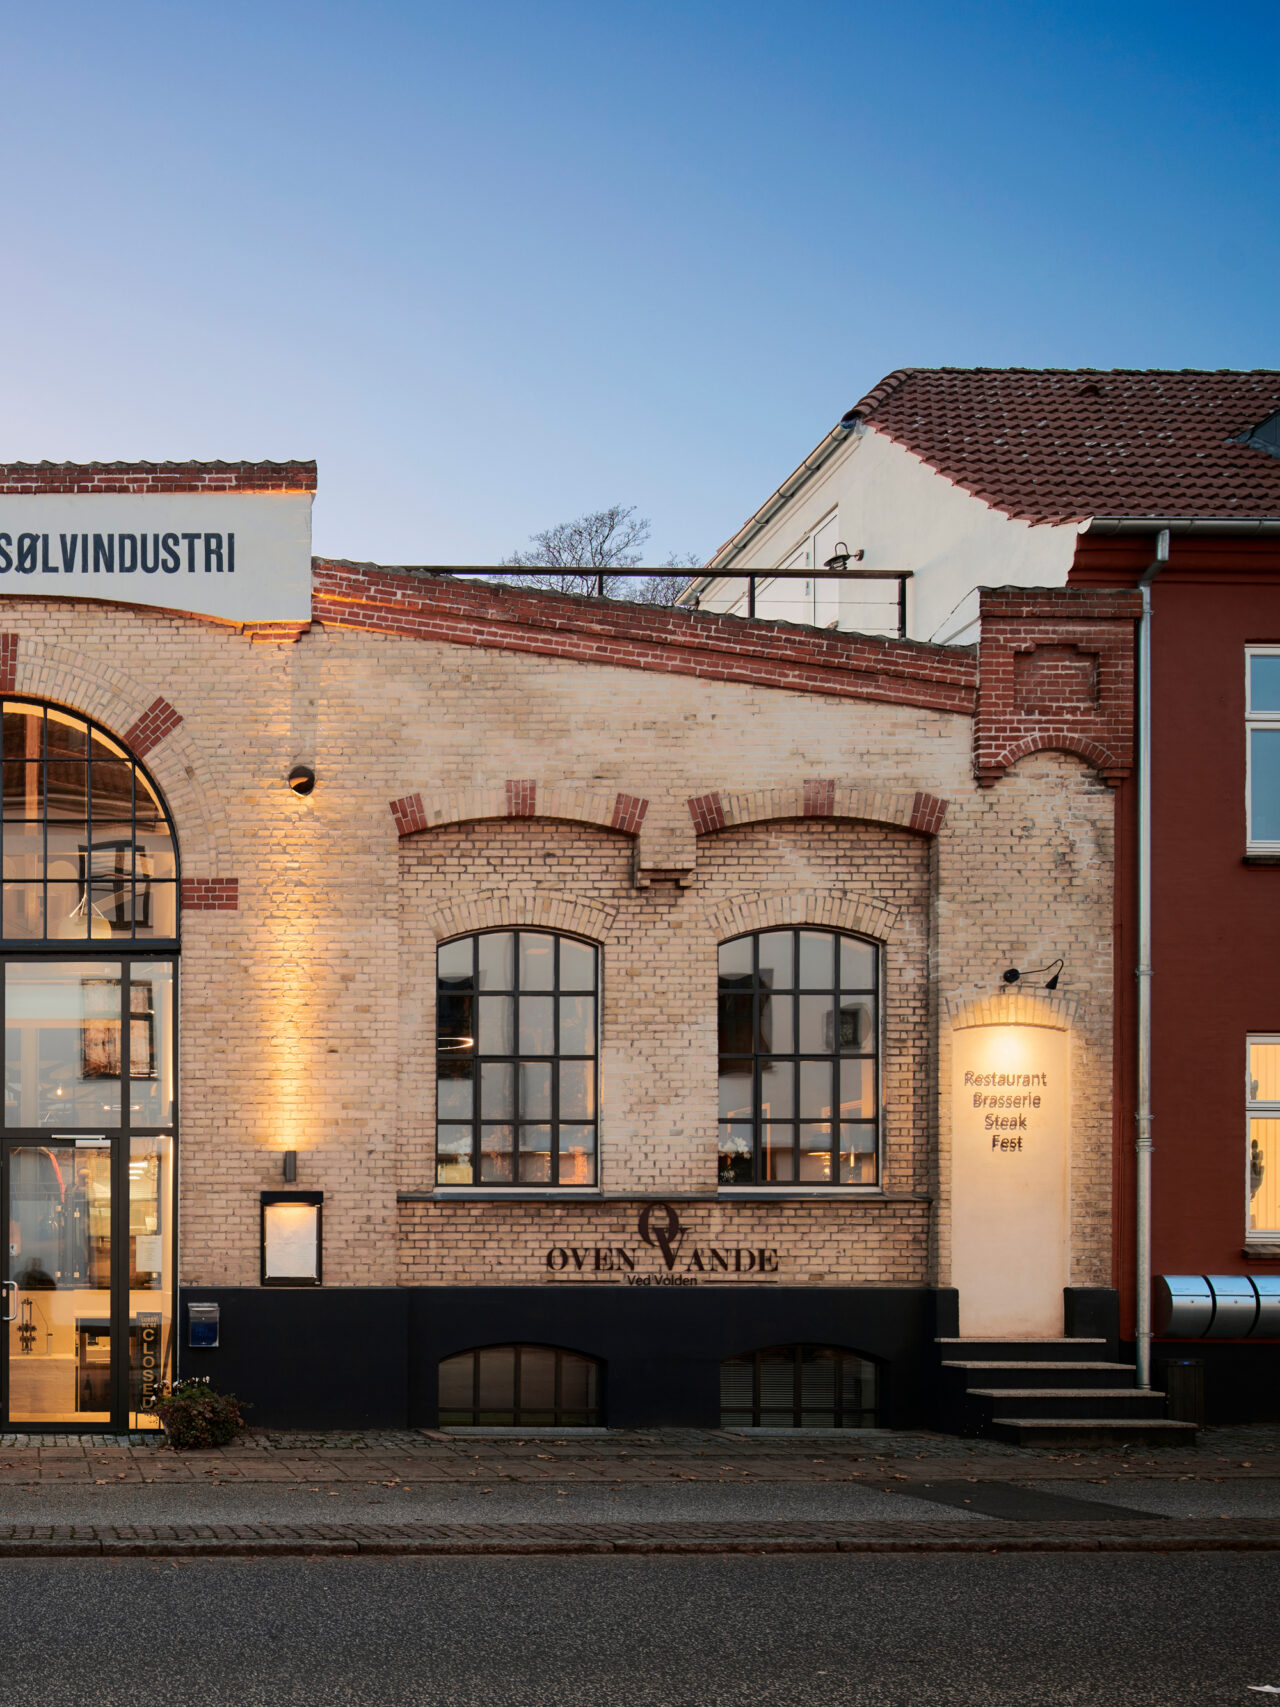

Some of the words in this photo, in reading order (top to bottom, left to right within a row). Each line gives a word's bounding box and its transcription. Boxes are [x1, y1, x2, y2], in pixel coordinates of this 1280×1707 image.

[964, 1071, 1048, 1087] Restaurant
[973, 1091, 1041, 1108] Brasserie
[984, 1113, 1027, 1130] Steak
[992, 1134, 1023, 1152] Fest
[546, 1247, 636, 1271] OVEN
[627, 1275, 651, 1286] Ved
[654, 1275, 697, 1286] Volden
[142, 1328, 155, 1409] CLOSED
